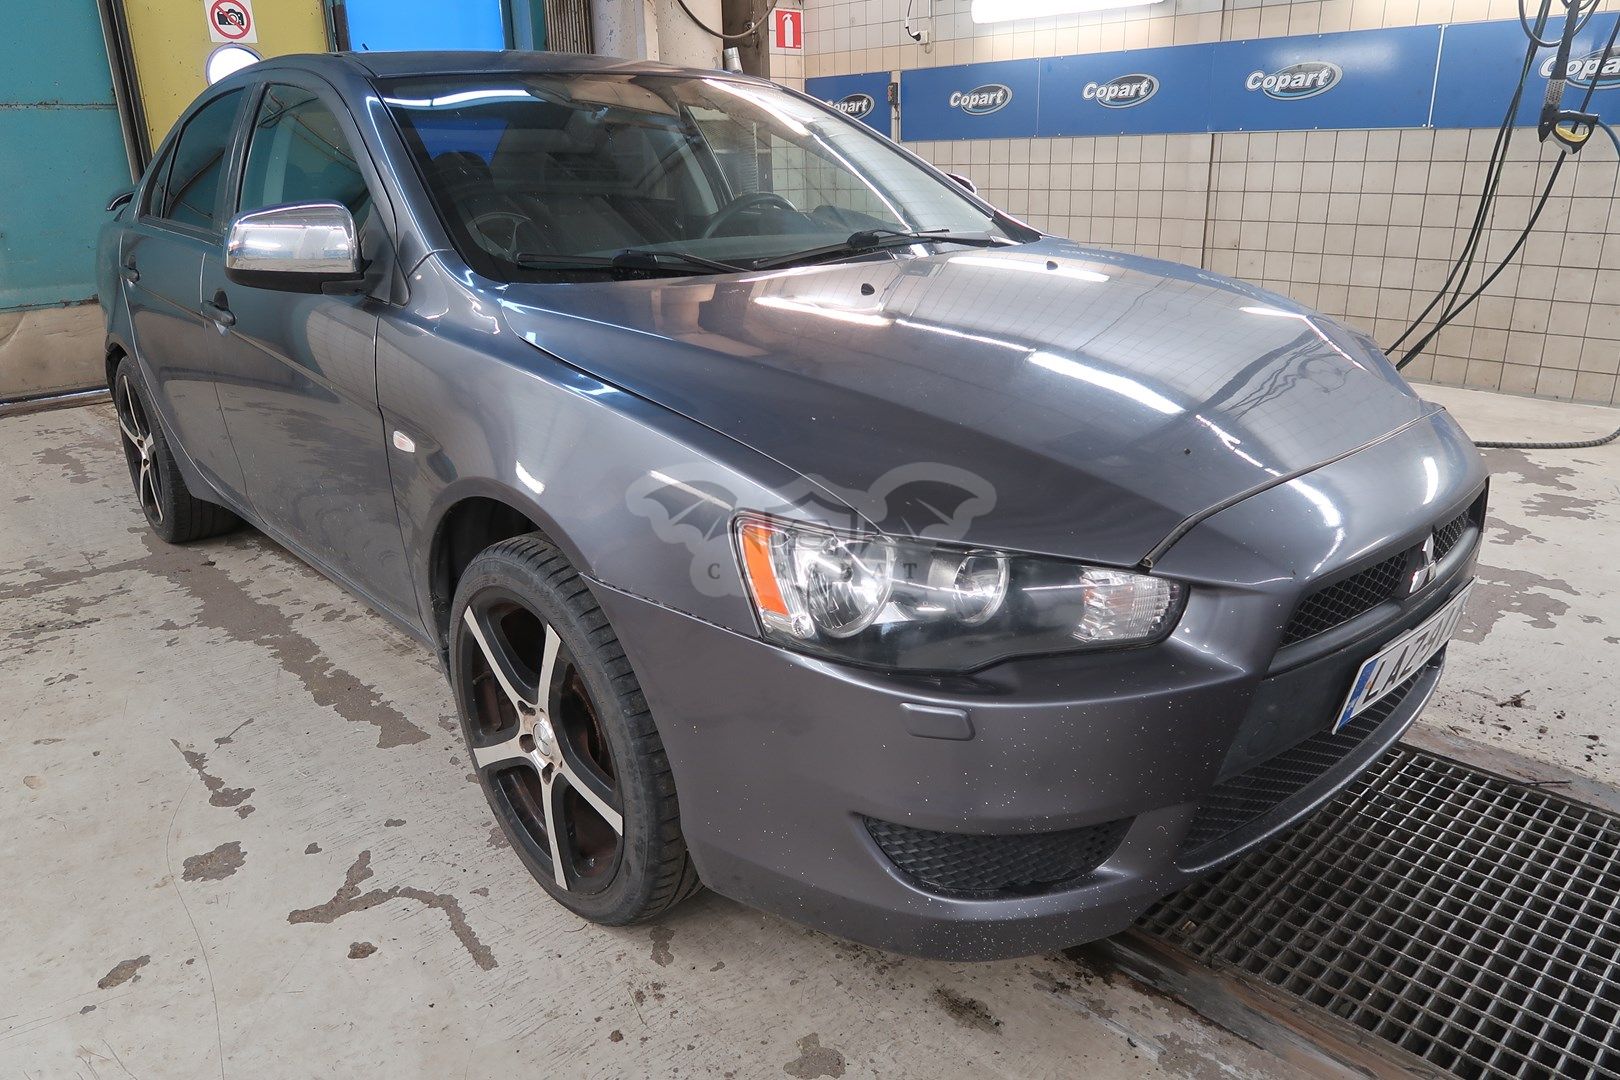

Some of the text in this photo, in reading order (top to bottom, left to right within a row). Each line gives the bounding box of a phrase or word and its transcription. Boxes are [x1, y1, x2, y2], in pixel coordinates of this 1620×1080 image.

[1083, 78, 1150, 101] Copart
[1247, 67, 1330, 93] Copart
[950, 88, 1004, 109] Copart
